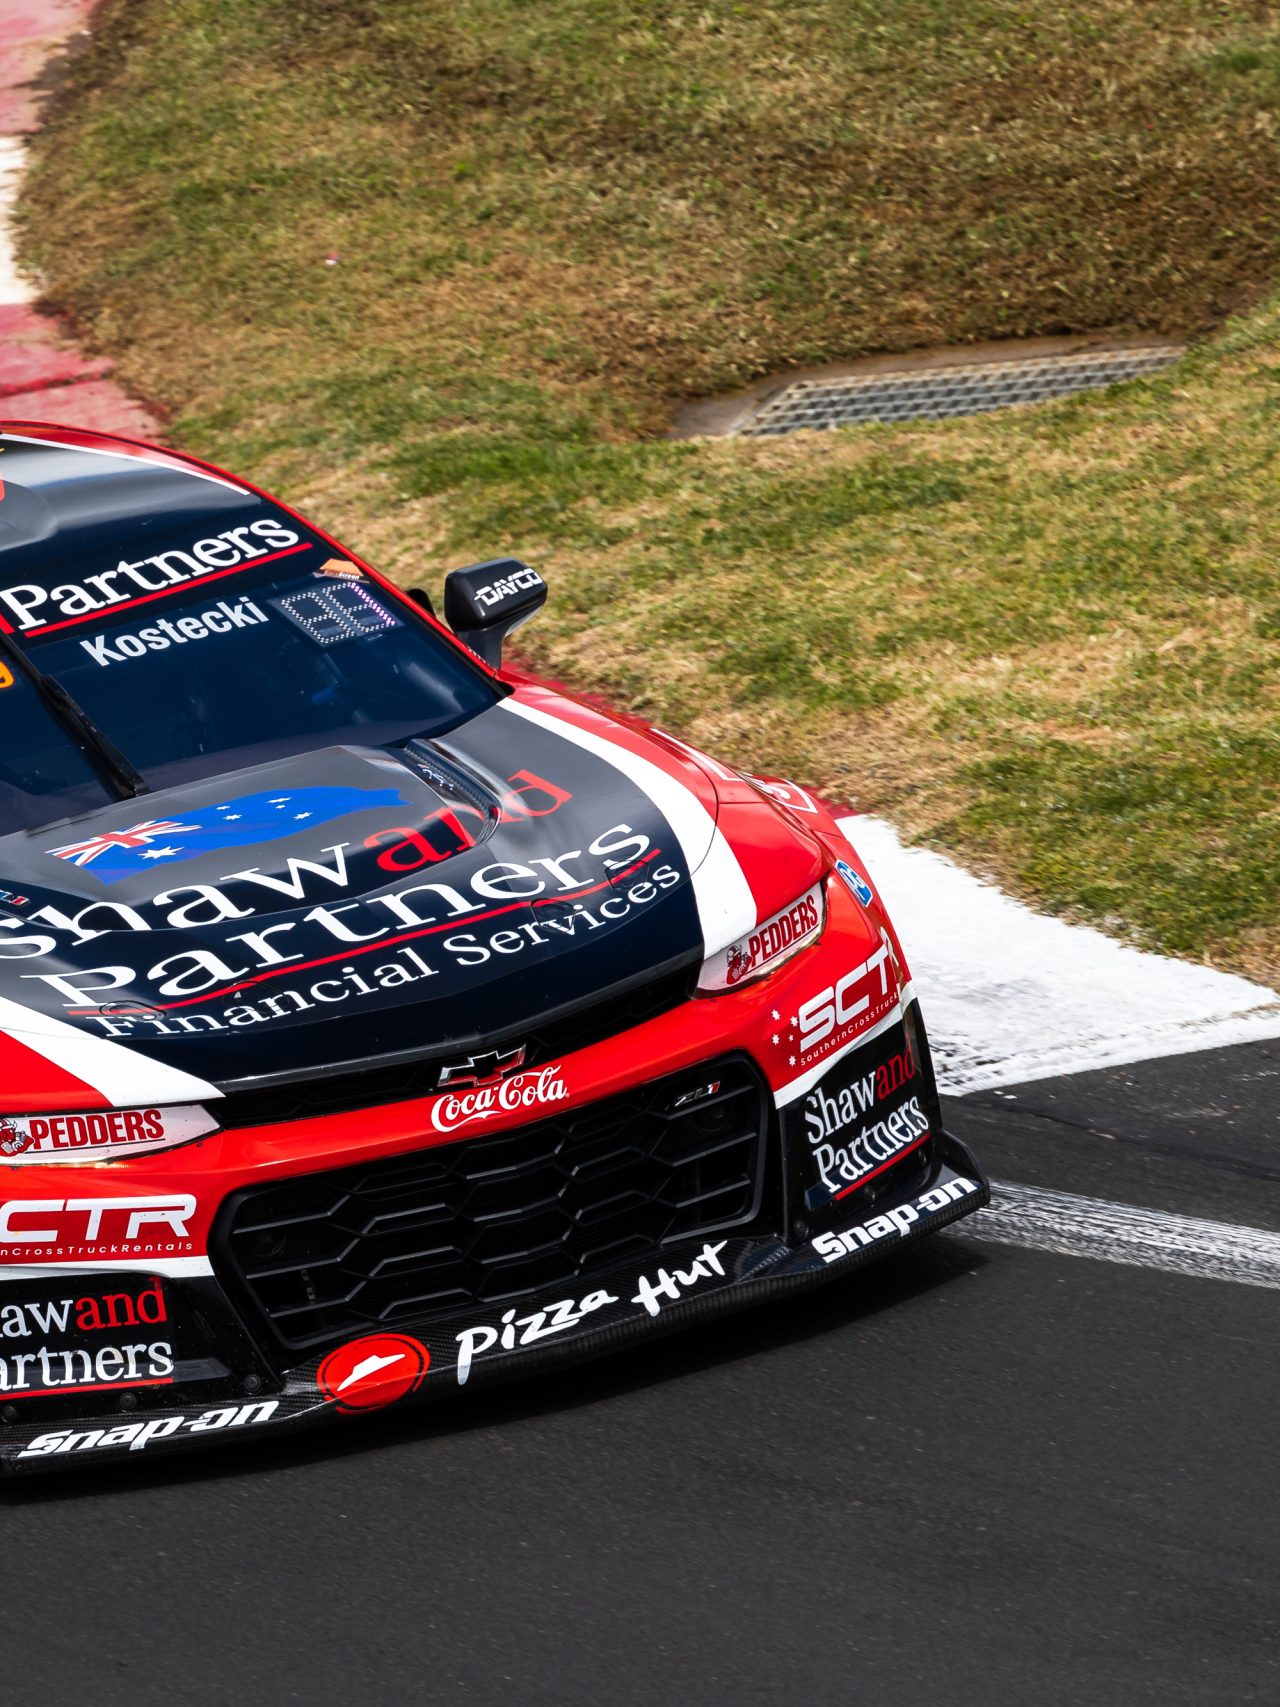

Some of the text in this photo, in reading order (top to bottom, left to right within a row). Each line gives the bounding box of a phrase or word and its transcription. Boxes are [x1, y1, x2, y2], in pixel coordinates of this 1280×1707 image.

[474, 568, 543, 606] DAYCO
[80, 596, 270, 667] Kostecki
[20, 823, 651, 1009] Partners
[85, 864, 681, 1039] Financial Services
[748, 894, 819, 969] PEDDERS
[29, 1109, 166, 1150] PEDDERS
[431, 1064, 567, 1133] Coca-Cola
[812, 1095, 929, 1196] Partners
[631, 1240, 728, 1317] Hut
